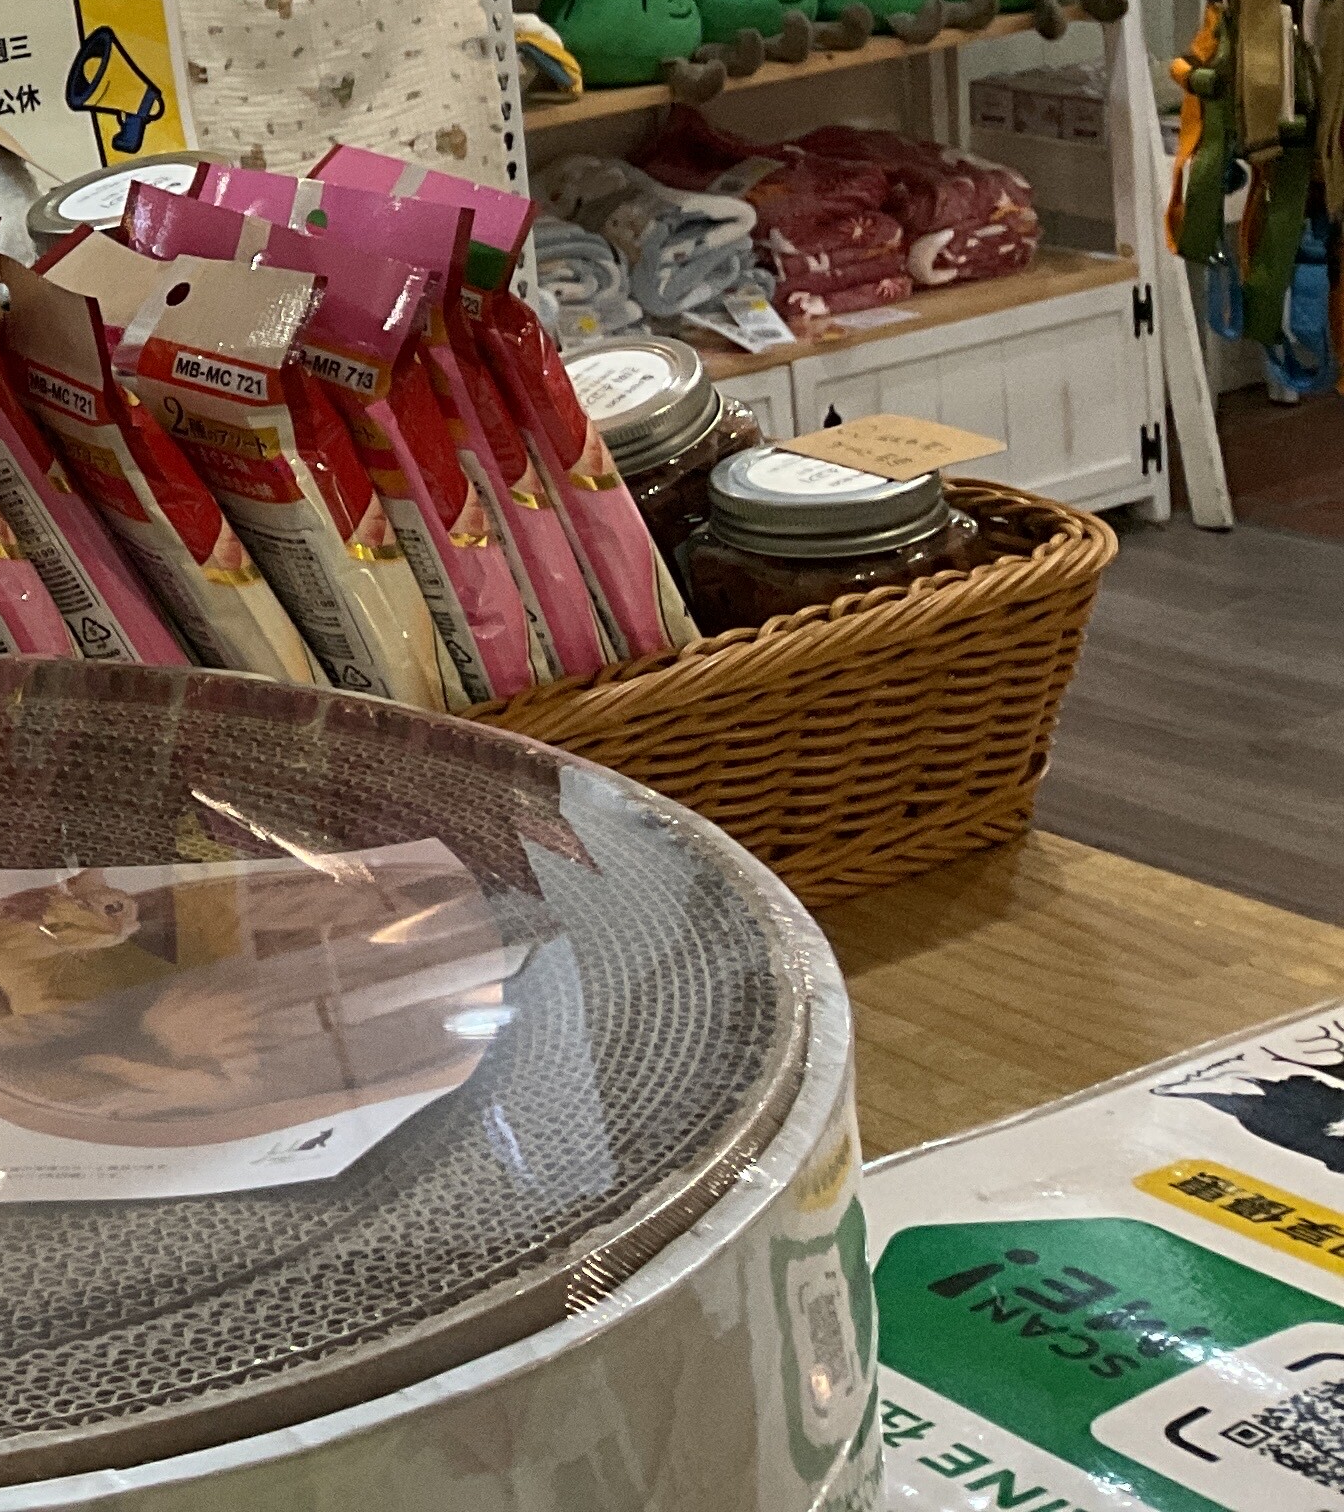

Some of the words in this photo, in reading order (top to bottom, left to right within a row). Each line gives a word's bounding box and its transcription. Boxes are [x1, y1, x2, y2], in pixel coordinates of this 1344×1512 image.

[173, 356, 233, 387] MB-MC
[236, 373, 264, 396] 721
[344, 365, 375, 390] 713
[72, 391, 94, 416] 721
[970, 1295, 1141, 1379] SCAN
[916, 1441, 1097, 1512] INE
